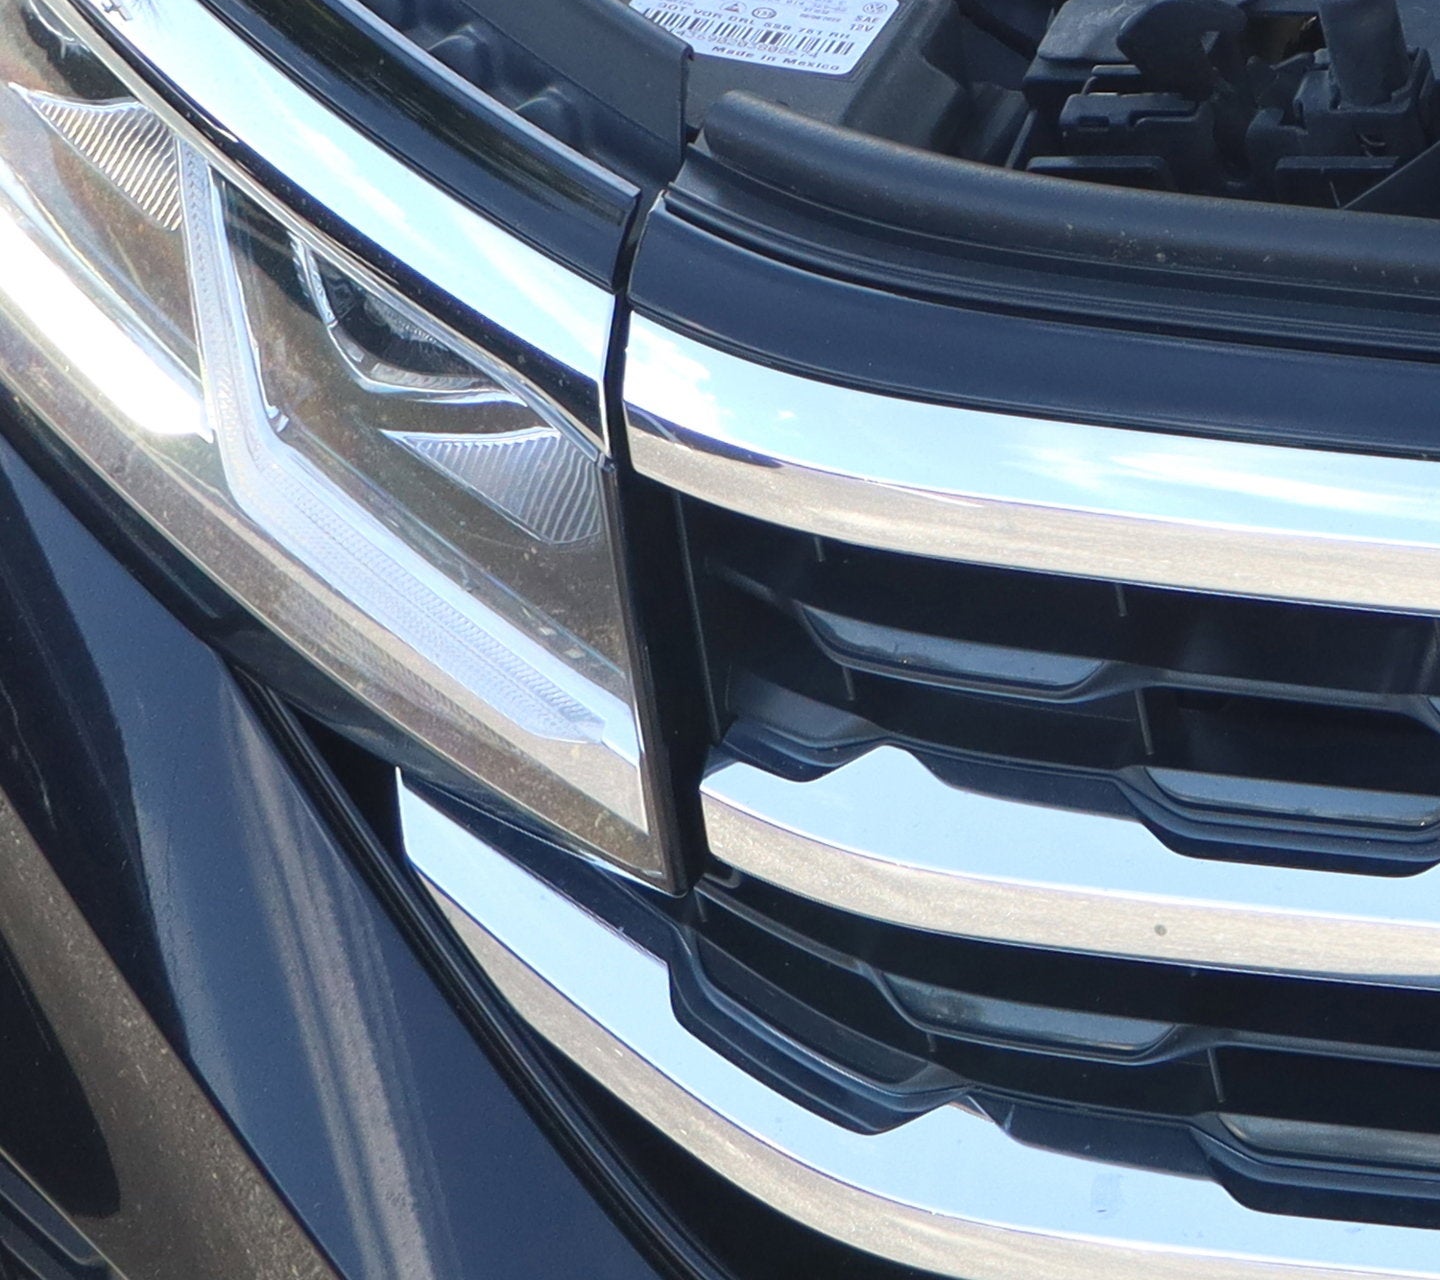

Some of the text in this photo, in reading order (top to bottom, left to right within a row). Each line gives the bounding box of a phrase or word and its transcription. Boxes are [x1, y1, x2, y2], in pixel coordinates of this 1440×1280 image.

[855, 15, 881, 24] SAE
[849, 23, 875, 33] 12V
[710, 45, 840, 71] Made in Mexico
